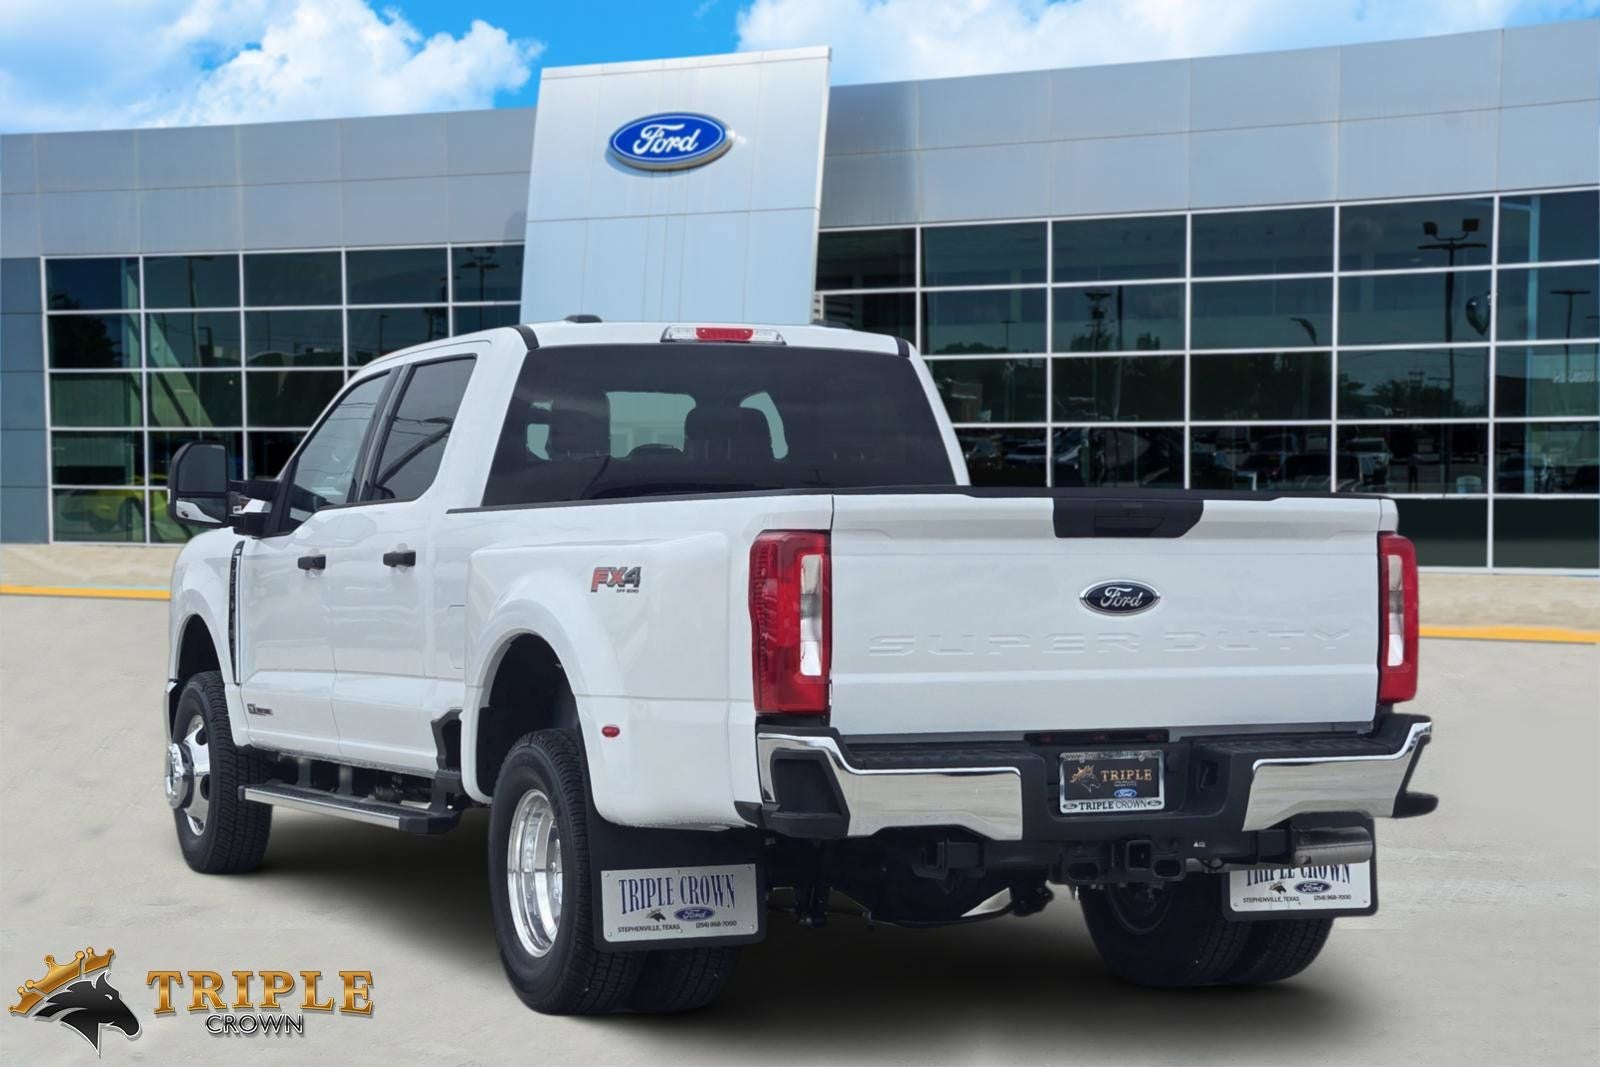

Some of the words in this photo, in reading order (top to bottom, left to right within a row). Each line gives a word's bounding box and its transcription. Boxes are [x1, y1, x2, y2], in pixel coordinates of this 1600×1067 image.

[633, 123, 701, 155] Ford
[591, 566, 641, 592] FX4
[1101, 586, 1143, 607] Ford
[868, 633, 1139, 656] SUPER
[1162, 629, 1350, 652] DUTY
[1101, 768, 1152, 782] TRIPLE
[1079, 801, 1114, 811] TRIPLE
[1115, 800, 1147, 809] CROWN
[619, 877, 674, 914] TRIPLE
[679, 874, 736, 909] CROWN
[683, 909, 707, 920] Ford
[662, 923, 680, 931] TEXAS
